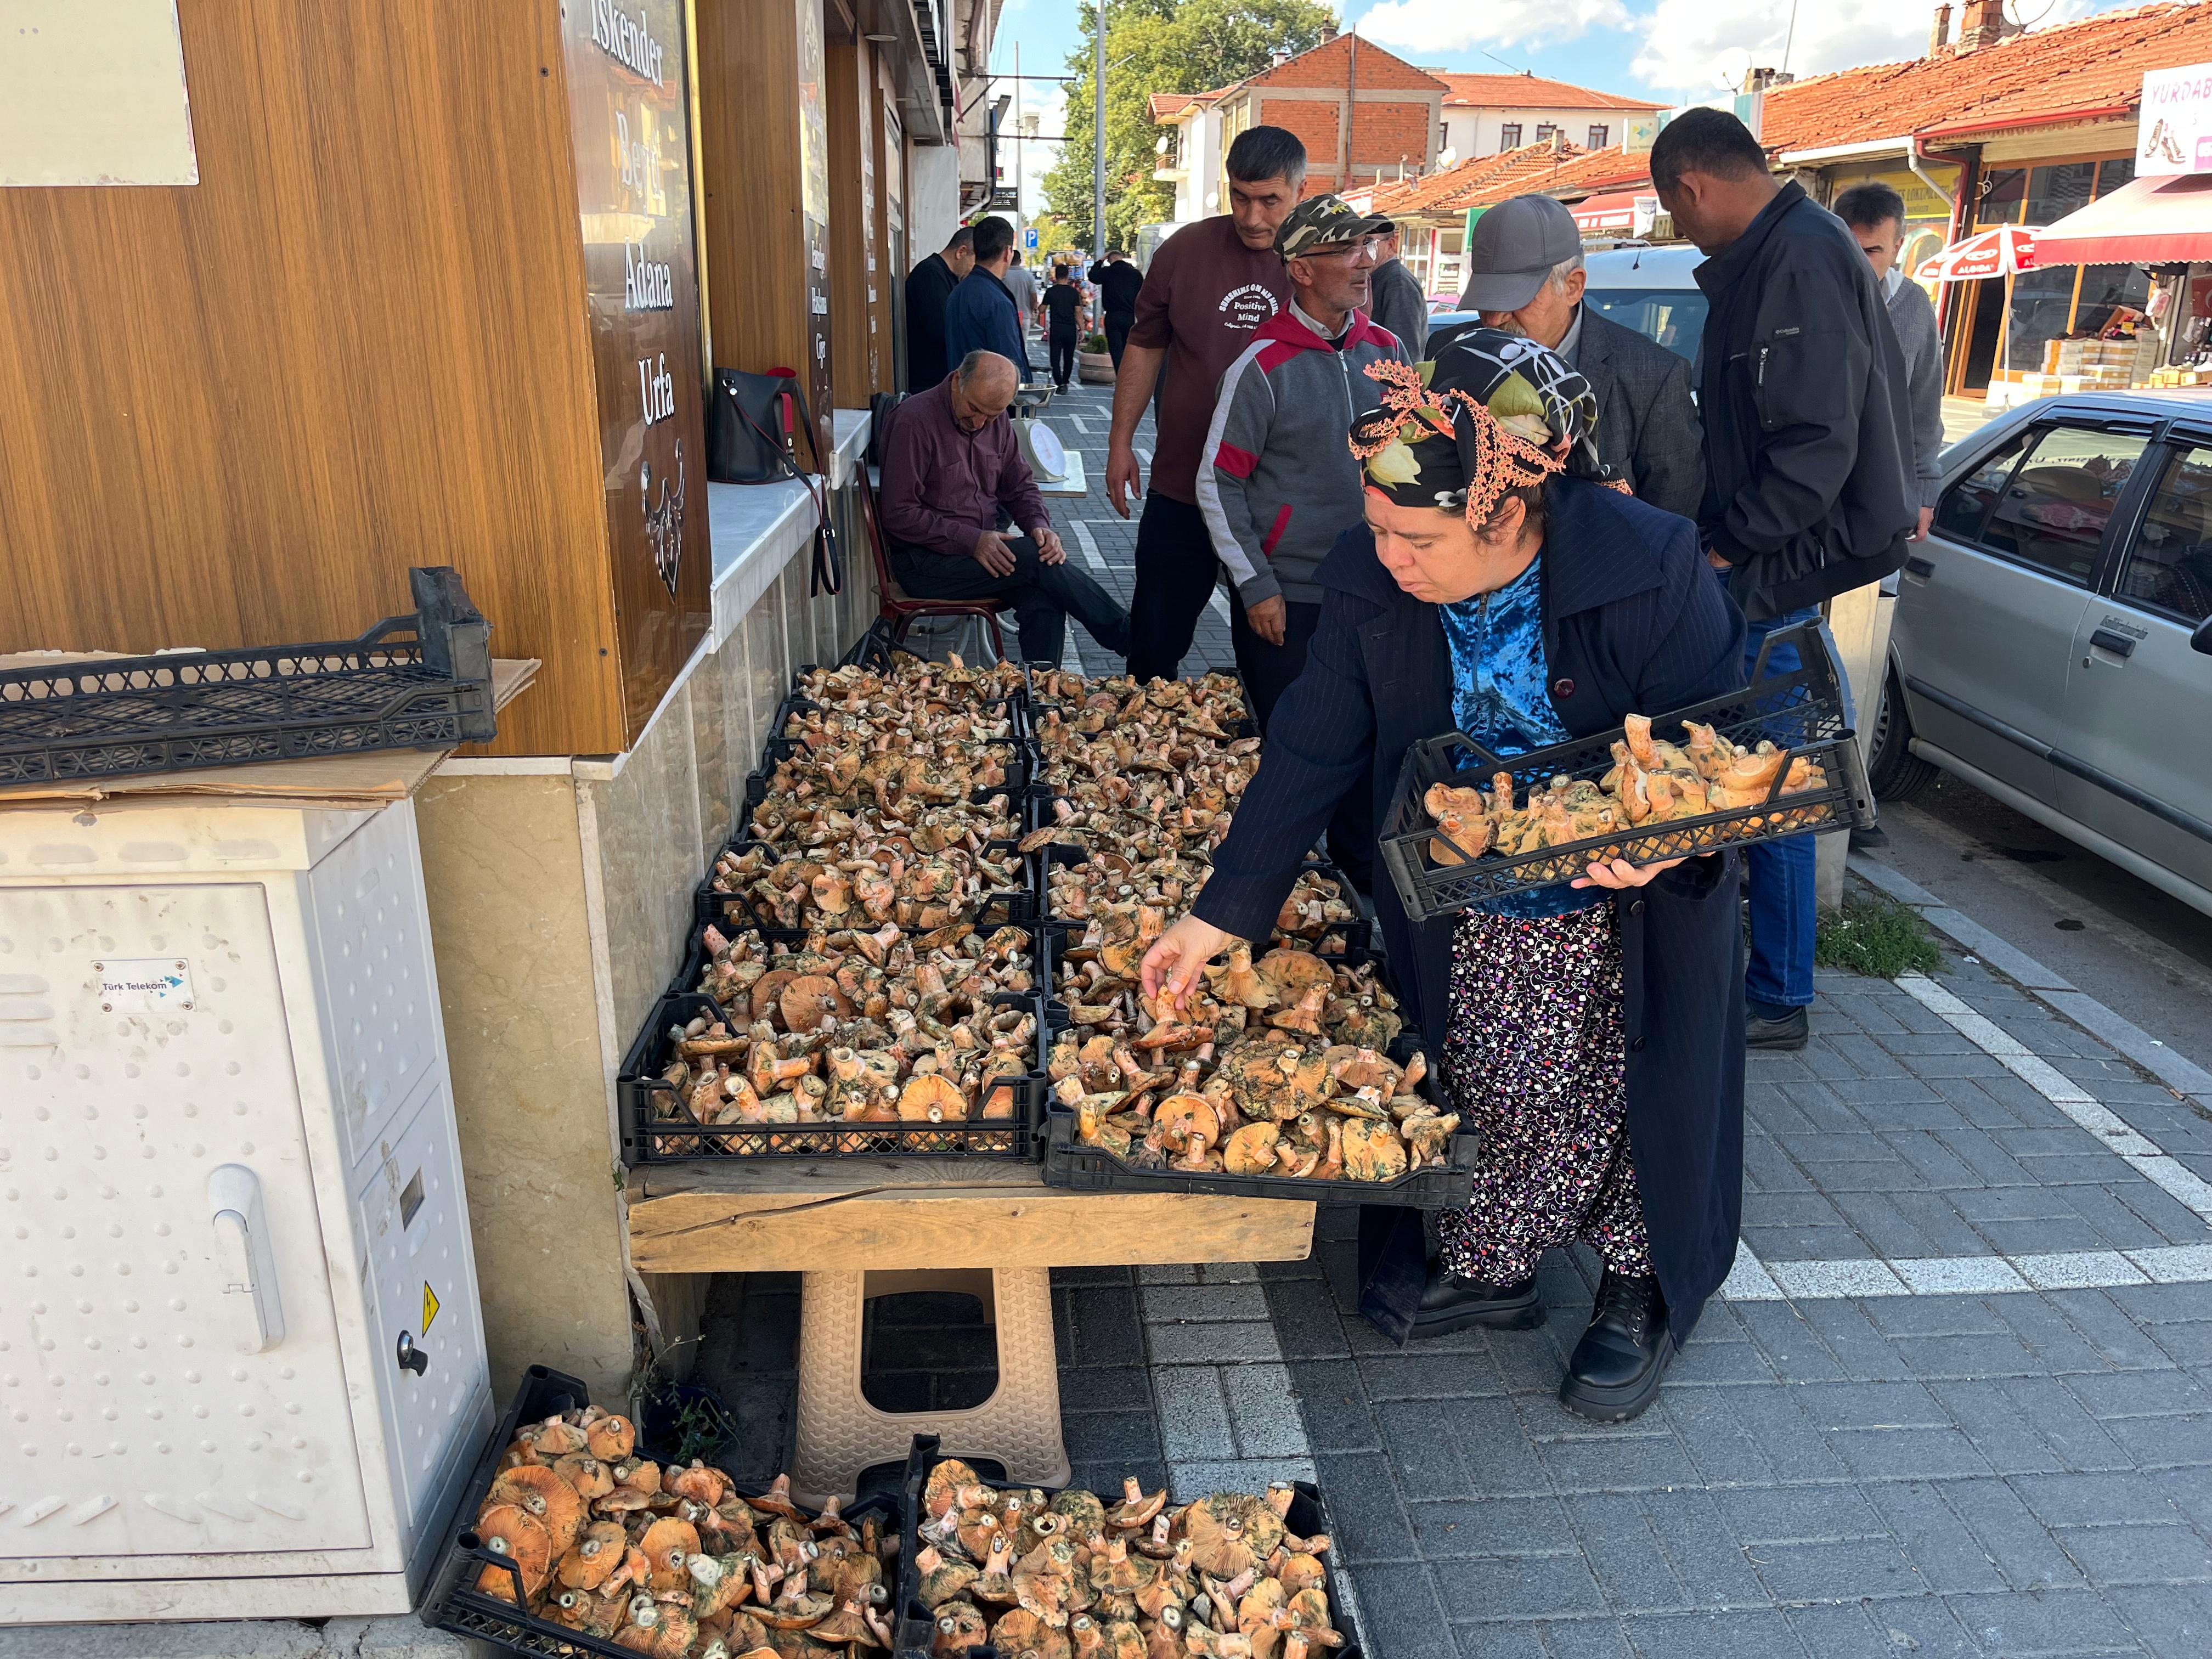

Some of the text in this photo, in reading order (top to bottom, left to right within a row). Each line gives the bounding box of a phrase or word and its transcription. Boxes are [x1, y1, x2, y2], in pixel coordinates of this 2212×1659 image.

[1028, 230, 1036, 246] P
[625, 236, 673, 309] Adana
[1250, 284, 1262, 292] ON
[1234, 301, 1267, 311] Positive
[1237, 312, 1260, 323] Mind
[639, 352, 674, 425] Urfa
[103, 982, 167, 991] Türk Telekom
